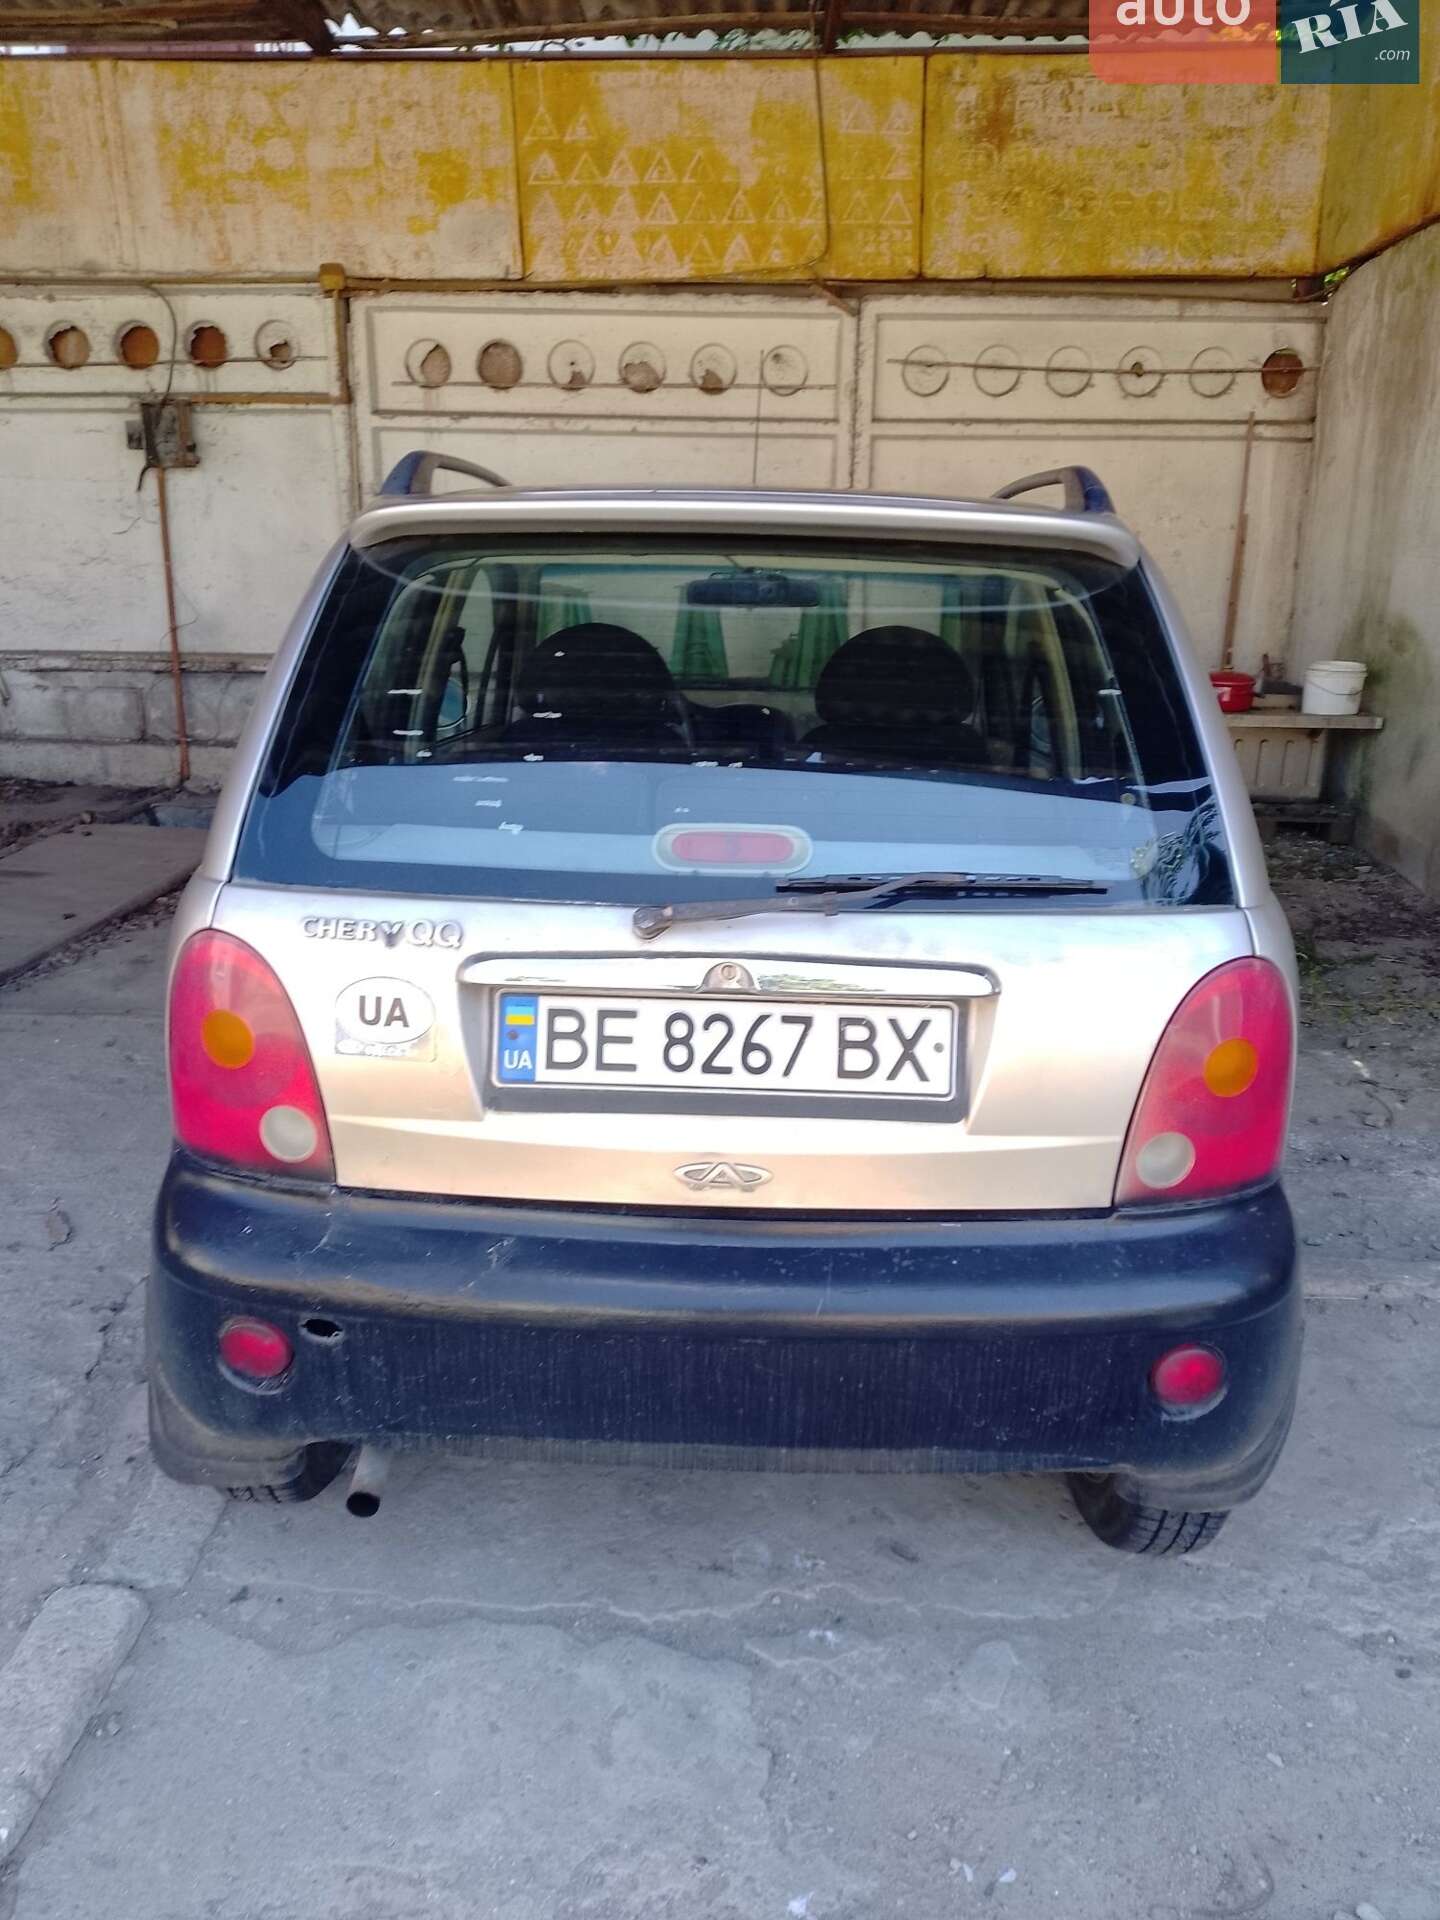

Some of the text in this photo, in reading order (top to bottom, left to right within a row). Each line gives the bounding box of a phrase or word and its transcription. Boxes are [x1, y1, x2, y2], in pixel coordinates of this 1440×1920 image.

[359, 994, 410, 1028] UA
[503, 1049, 532, 1070] UA
[545, 1008, 932, 1083] BE 8267 BX
